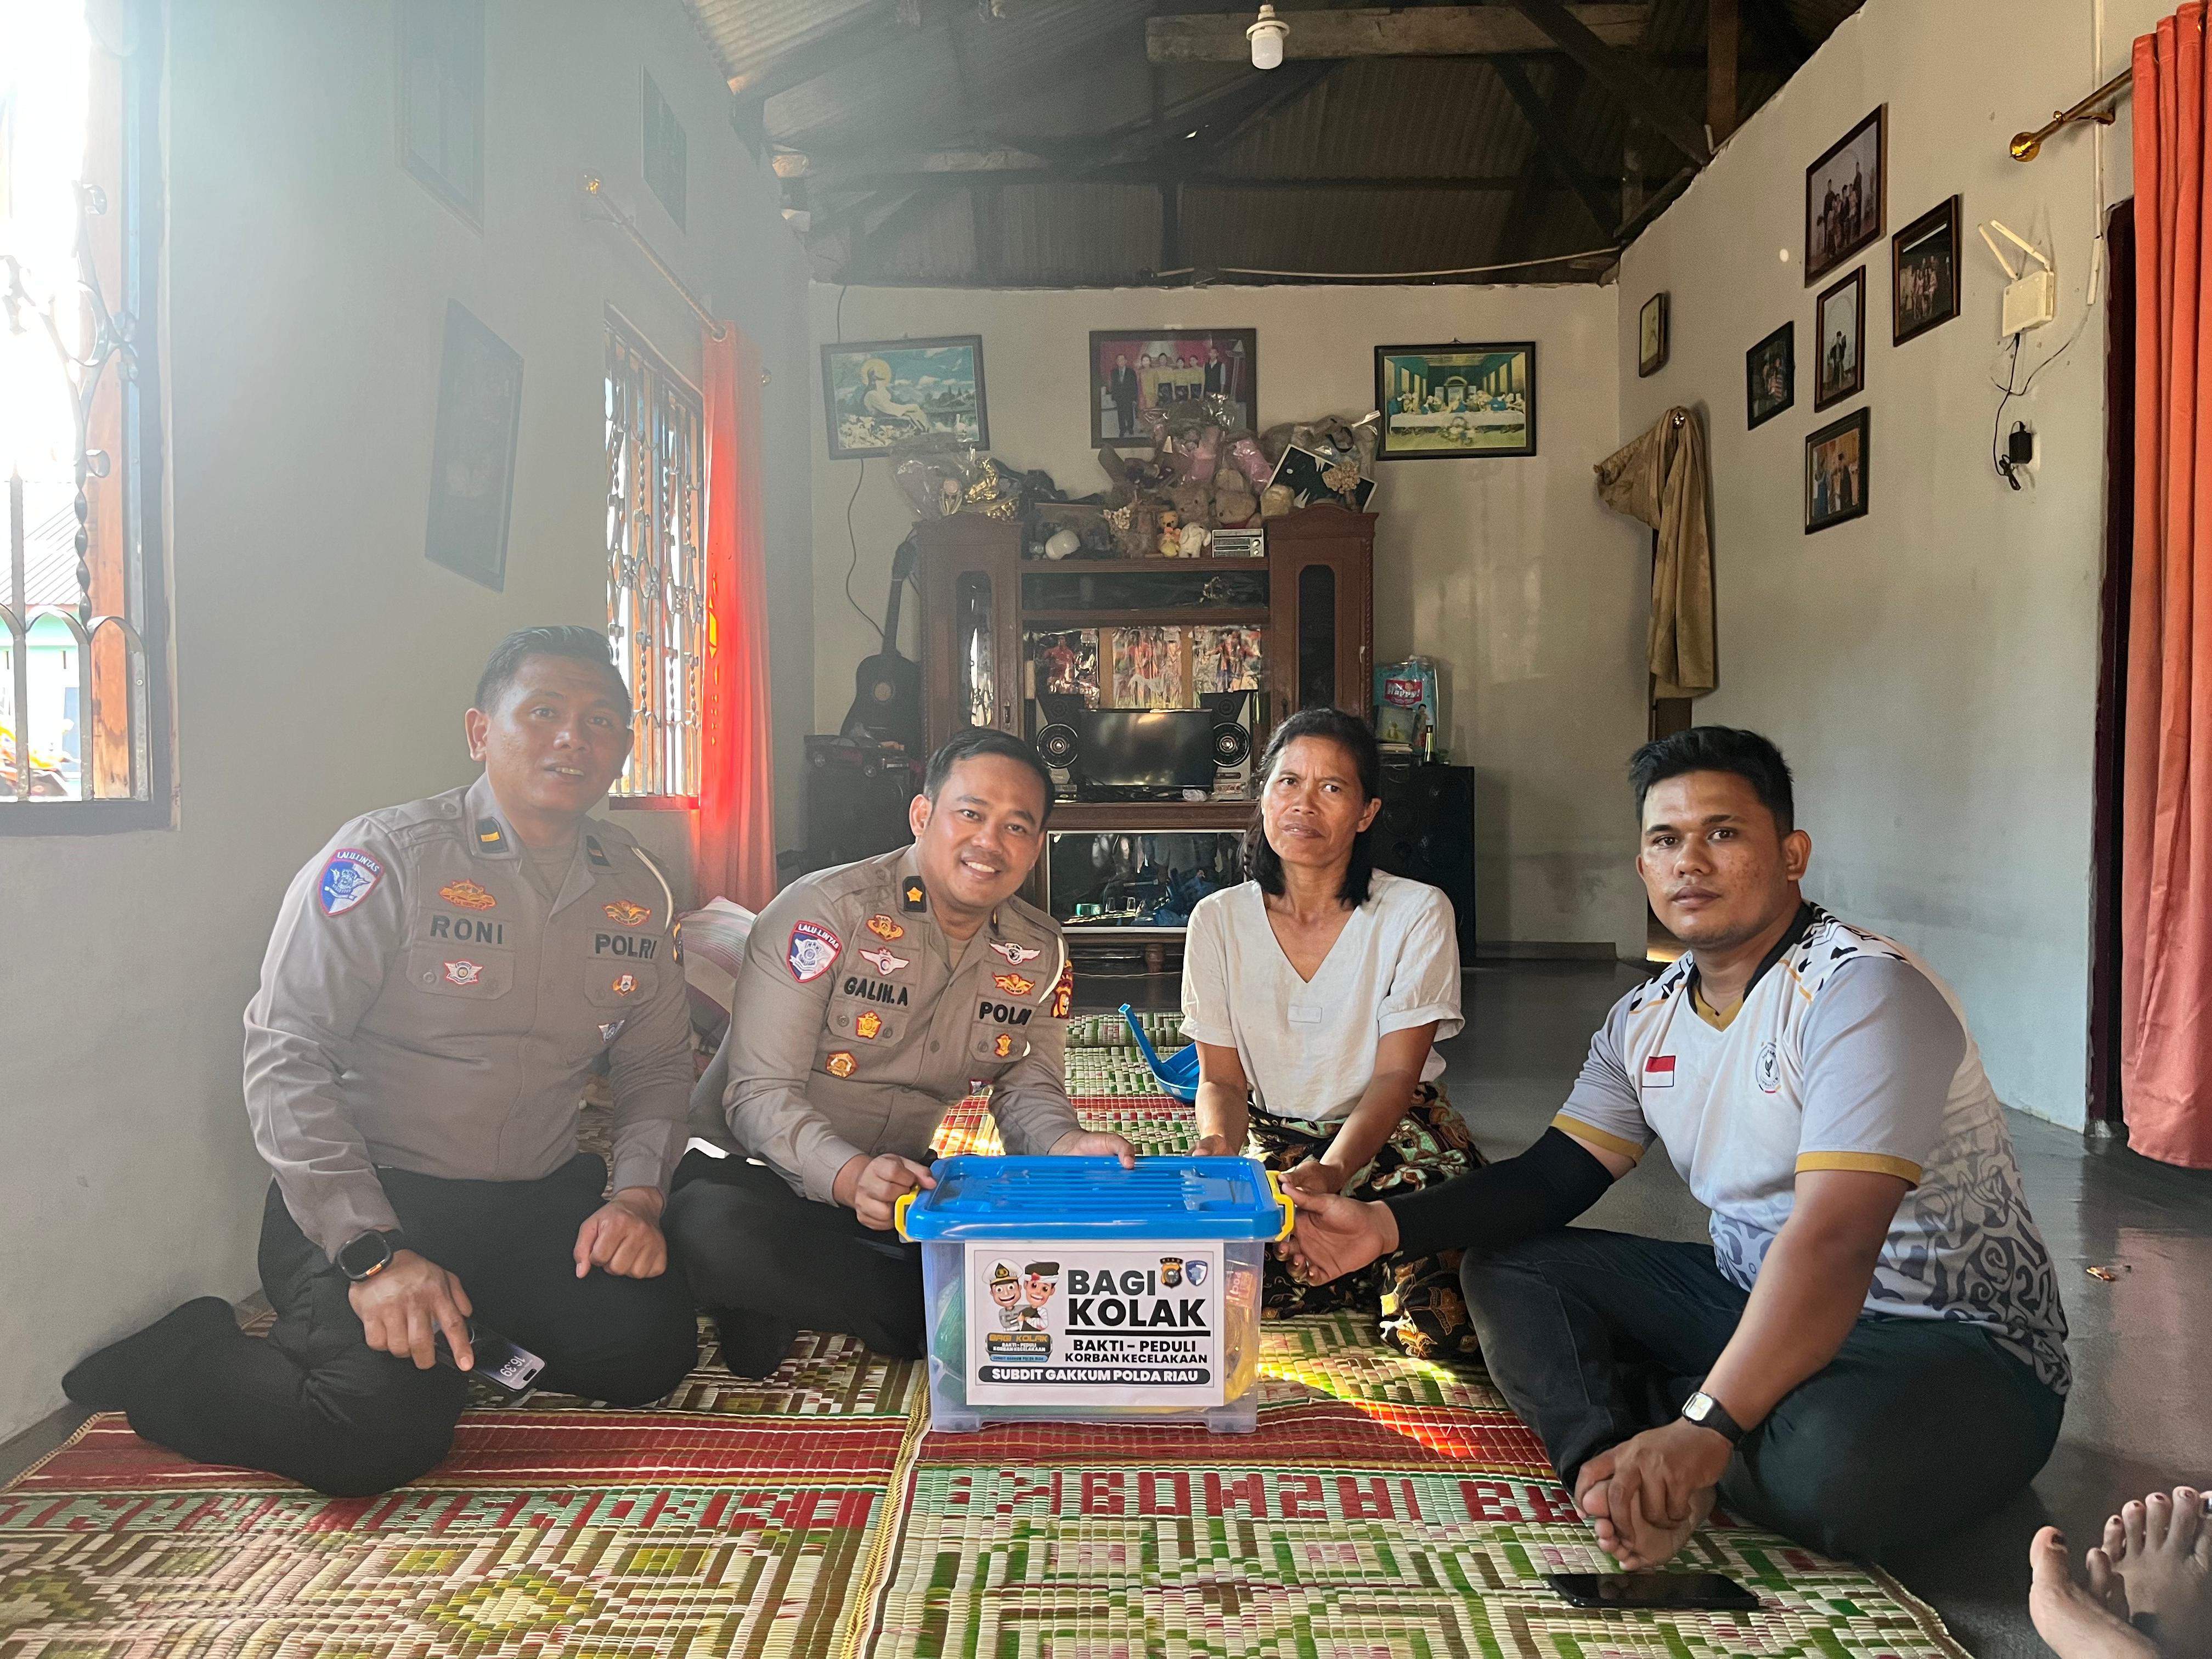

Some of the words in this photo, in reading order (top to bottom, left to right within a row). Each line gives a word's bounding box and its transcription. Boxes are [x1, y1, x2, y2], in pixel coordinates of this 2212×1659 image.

[430, 915, 503, 944] RONI
[798, 923, 817, 934] LALU
[596, 934, 657, 959] POLRI
[1068, 1269, 1155, 1296] BAGI
[1069, 1298, 1207, 1327] KOLAK
[1074, 1339, 1124, 1351] BAKTI
[1139, 1340, 1196, 1352] PEDULI
[500, 1356, 526, 1377] 16.39
[1065, 1353, 1119, 1362] KORBAN
[1122, 1354, 1207, 1363] KECELAKAAN
[992, 1368, 1043, 1381] SUBDIT
[1045, 1369, 1110, 1381] GAKKUM
[1113, 1369, 1161, 1382] POLDA
[1164, 1370, 1198, 1382] RIAU
